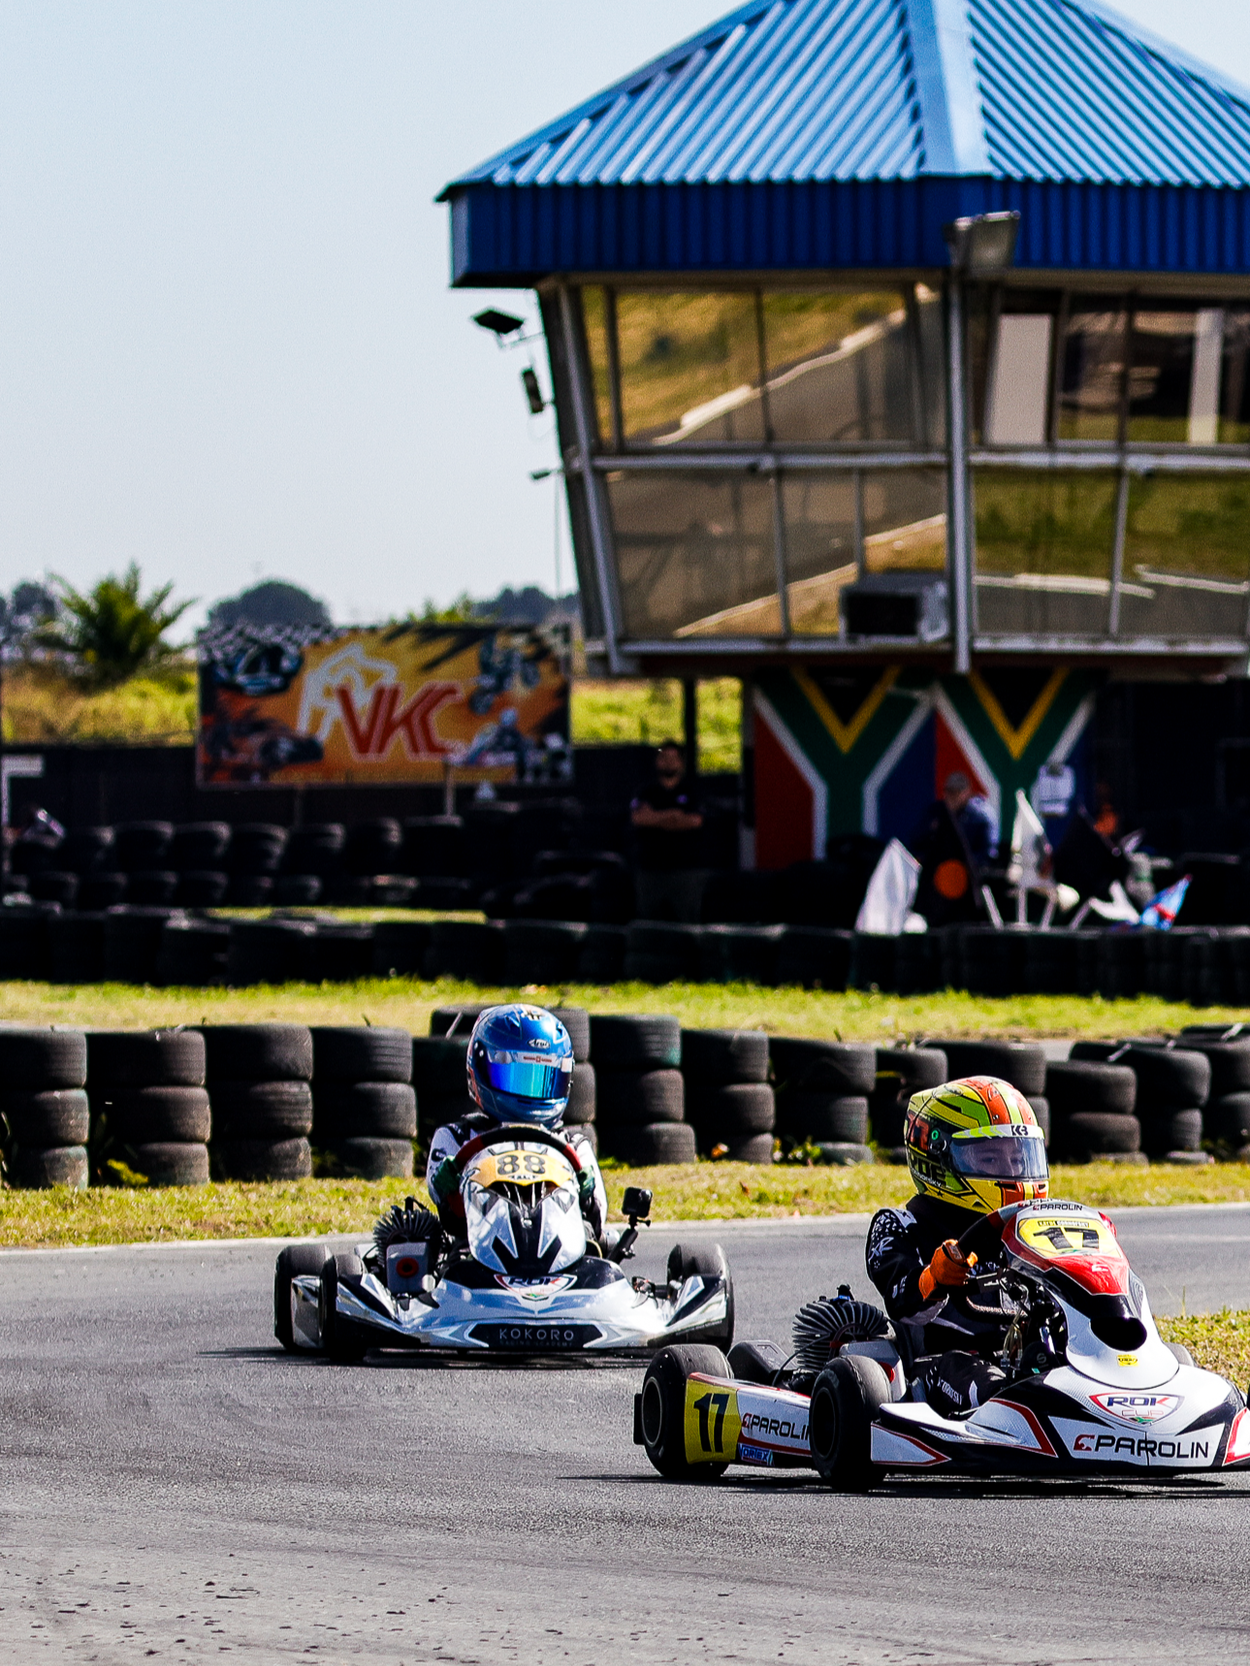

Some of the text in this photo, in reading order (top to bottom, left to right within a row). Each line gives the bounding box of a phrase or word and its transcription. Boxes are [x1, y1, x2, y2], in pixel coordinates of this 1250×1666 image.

[335, 682, 461, 760] VKC
[497, 1154, 546, 1175] 88
[1040, 1203, 1083, 1211] PAROLIN
[1033, 1226, 1100, 1250] 17
[499, 1328, 574, 1341] KOKORO
[1107, 1396, 1170, 1408] ROK
[693, 1393, 730, 1453] 17
[1095, 1435, 1209, 1459] PAROLIN
